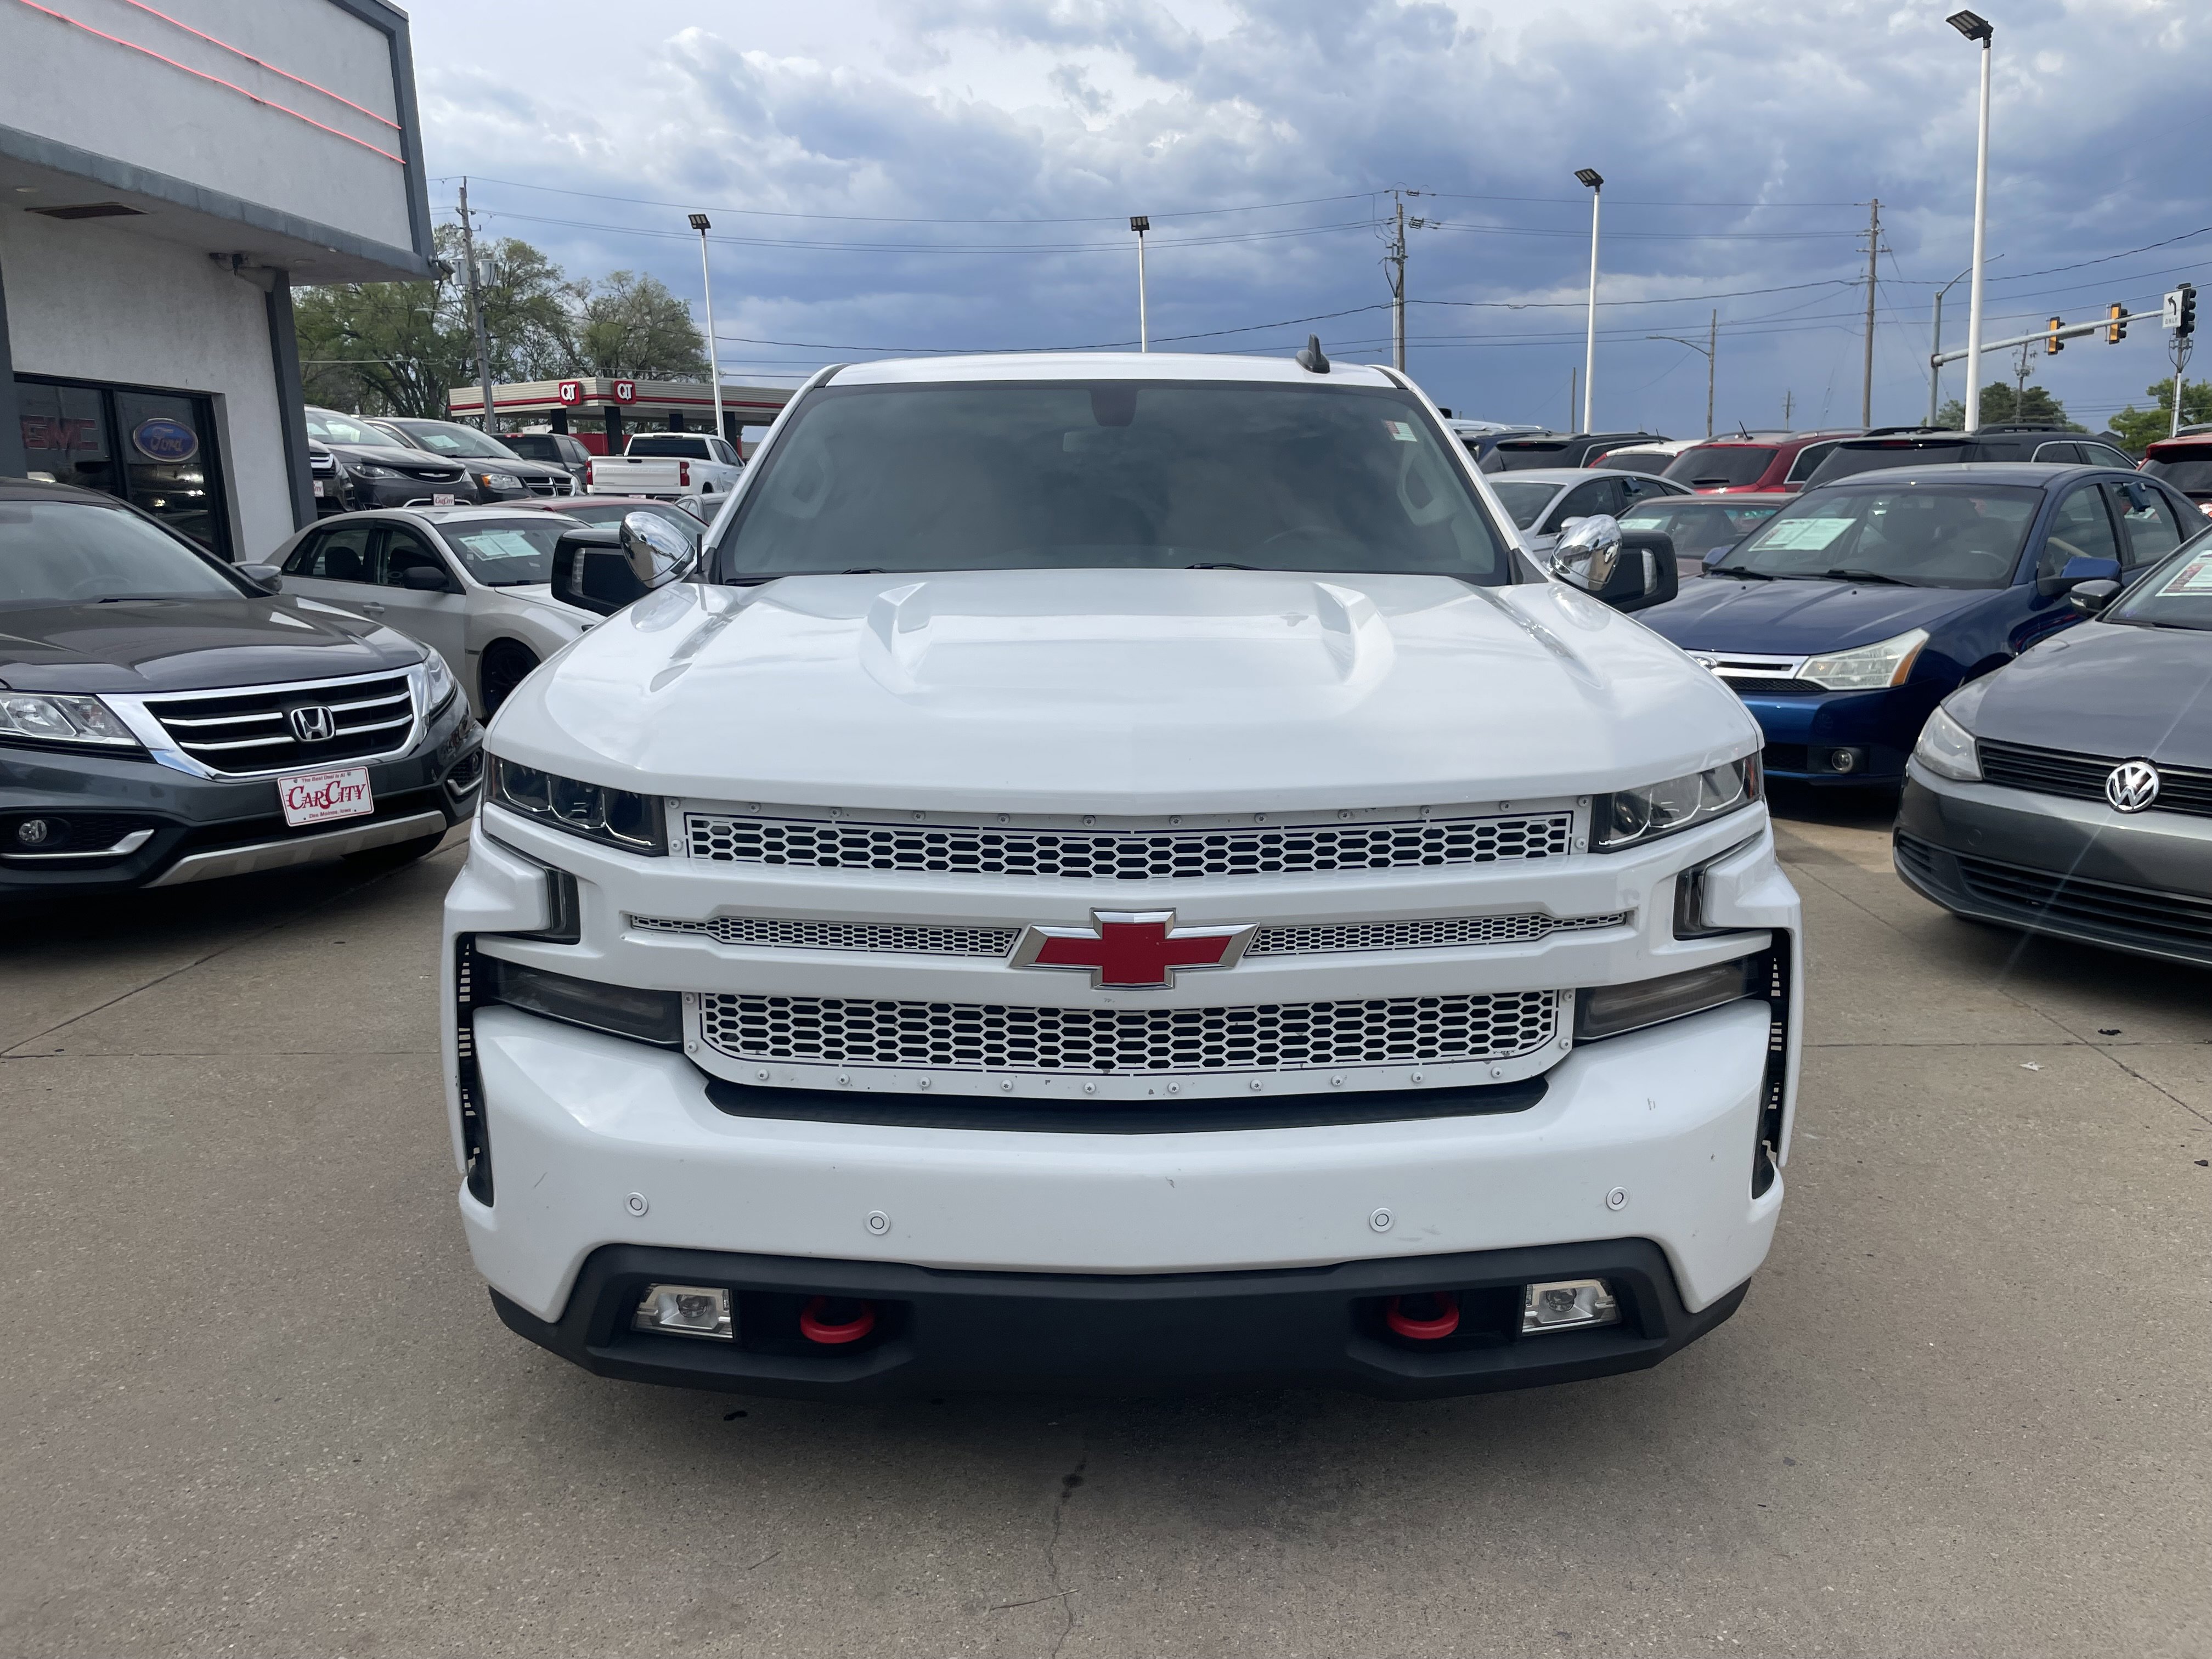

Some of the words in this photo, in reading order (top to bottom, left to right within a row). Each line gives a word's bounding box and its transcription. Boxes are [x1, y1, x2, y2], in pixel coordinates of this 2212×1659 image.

[561, 384, 575, 402] QT
[617, 383, 633, 400] QT
[20, 414, 101, 452] GMC
[150, 426, 183, 452] Ford
